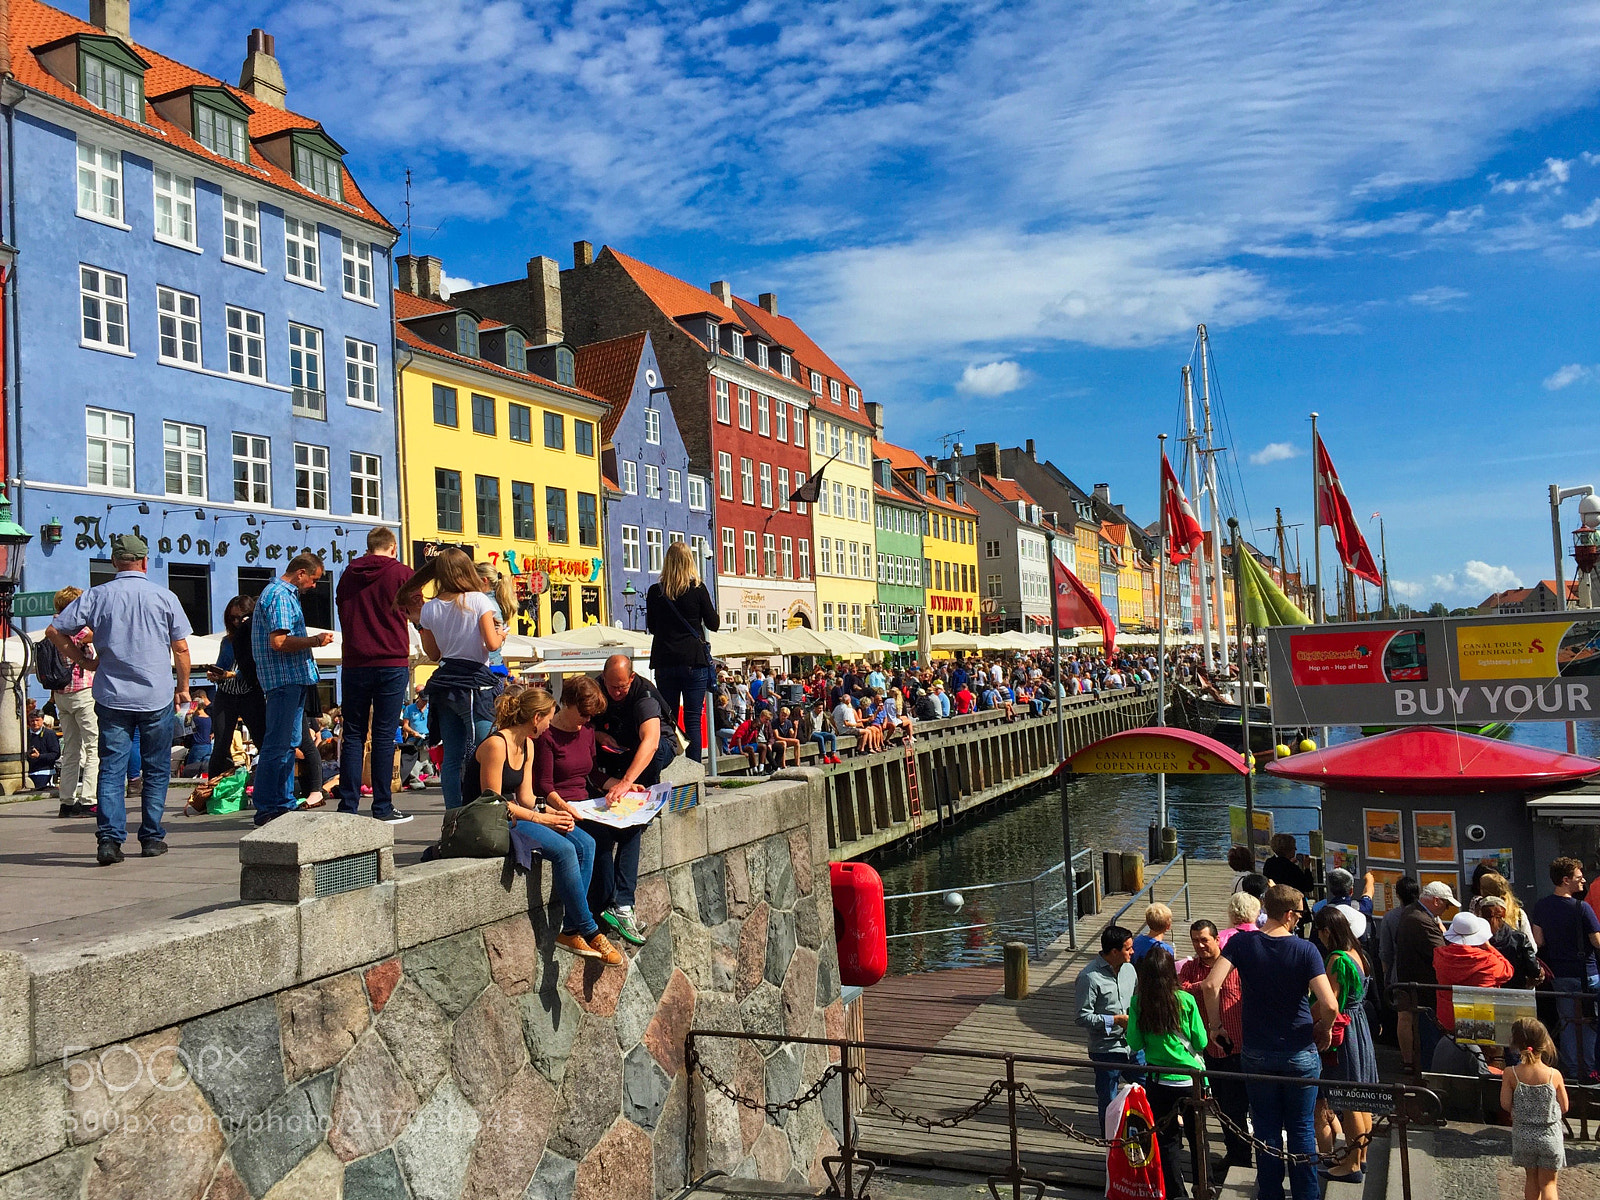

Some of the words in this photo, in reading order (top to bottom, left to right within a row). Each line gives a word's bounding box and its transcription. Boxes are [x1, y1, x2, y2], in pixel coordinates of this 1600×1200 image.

[240, 530, 369, 563] Færekr
[16, 596, 54, 613] TOIL
[930, 595, 964, 612] NYHAVN
[981, 600, 994, 612] 17
[1463, 642, 1492, 650] CANAL
[1463, 648, 1524, 657] COPENHAGEN
[1394, 686, 1471, 716] BUY
[1480, 683, 1592, 714] YOUR
[1096, 751, 1135, 760] CANAL
[1137, 751, 1176, 760] TOURS
[1095, 761, 1179, 771] COPENHAGEN
[1329, 1089, 1343, 1097] KUN
[1346, 1090, 1376, 1100] ADGANG
[1378, 1093, 1393, 1101] FOR
